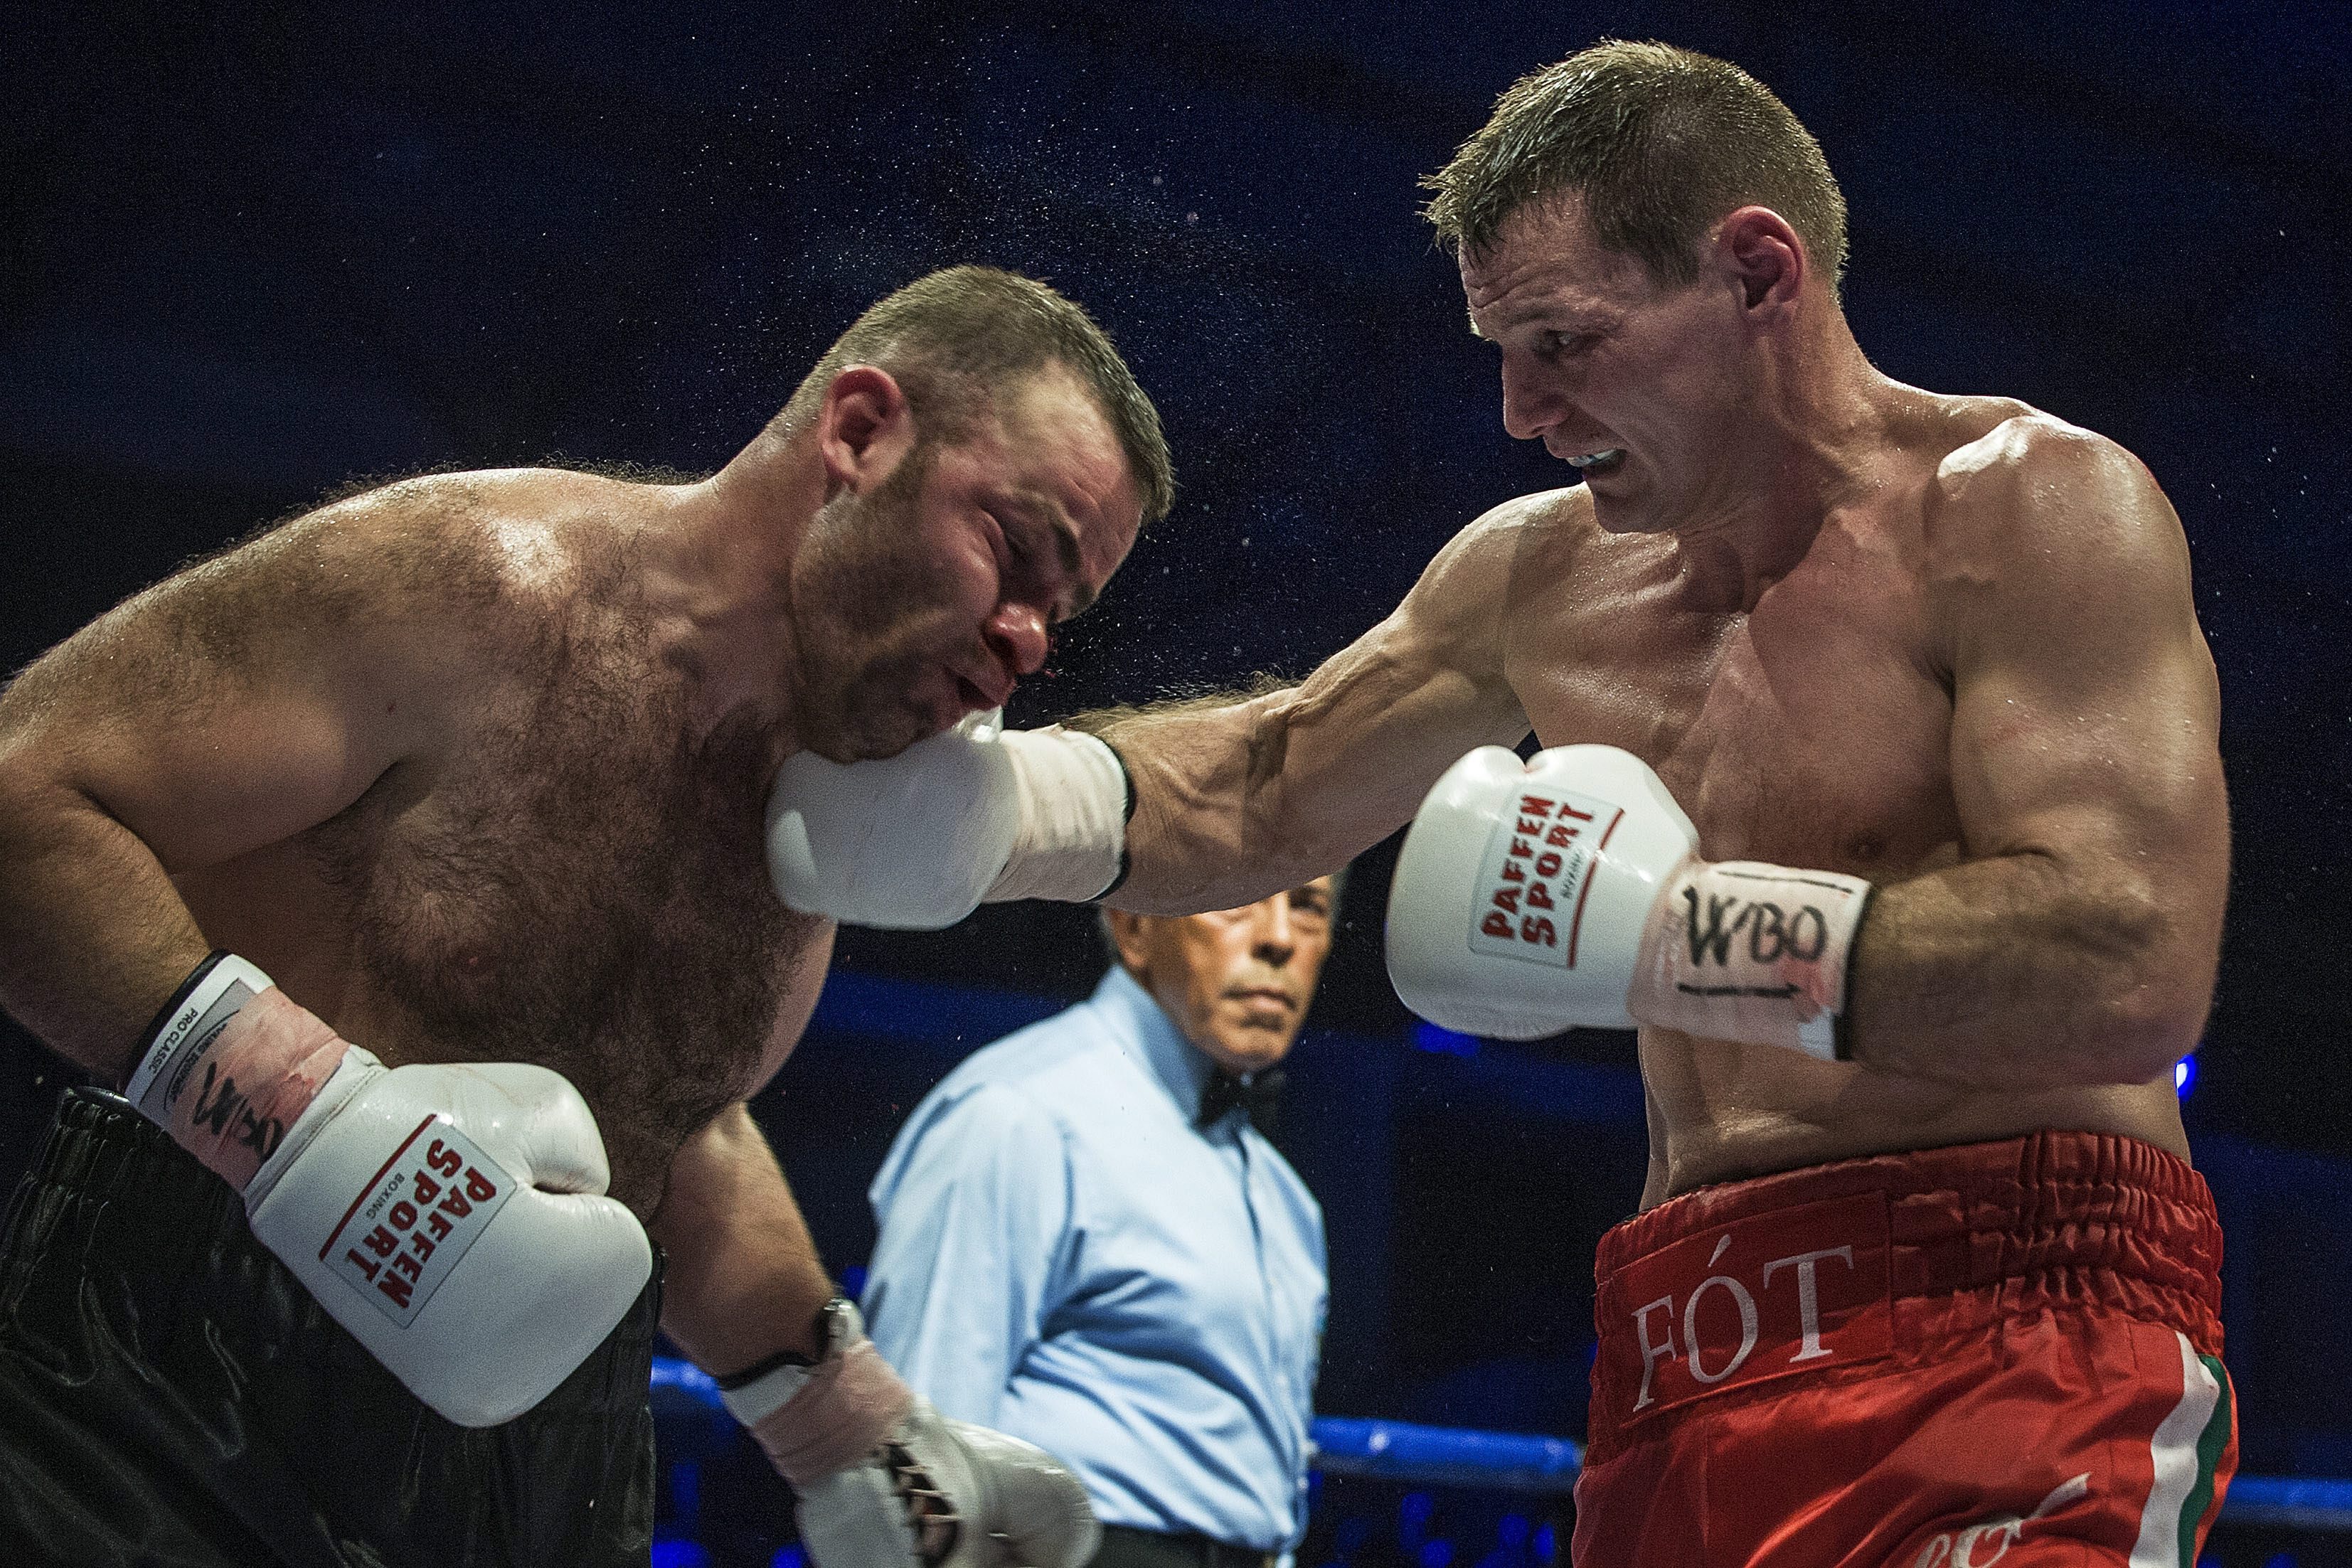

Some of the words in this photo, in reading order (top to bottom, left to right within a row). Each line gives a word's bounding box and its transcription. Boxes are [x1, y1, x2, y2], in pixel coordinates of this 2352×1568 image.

[1481, 794, 1555, 940] PAFFEN
[1520, 803, 1595, 949] SPORT
[1683, 884, 1828, 968] WBO
[148, 1030, 179, 1074] CLASSIC
[176, 1007, 198, 1031] PRO
[344, 1138, 464, 1283] SPORT
[366, 1173, 405, 1220] BOXING
[372, 1166, 497, 1309] PAFFEN
[1631, 1234, 1854, 1412] FÓT
